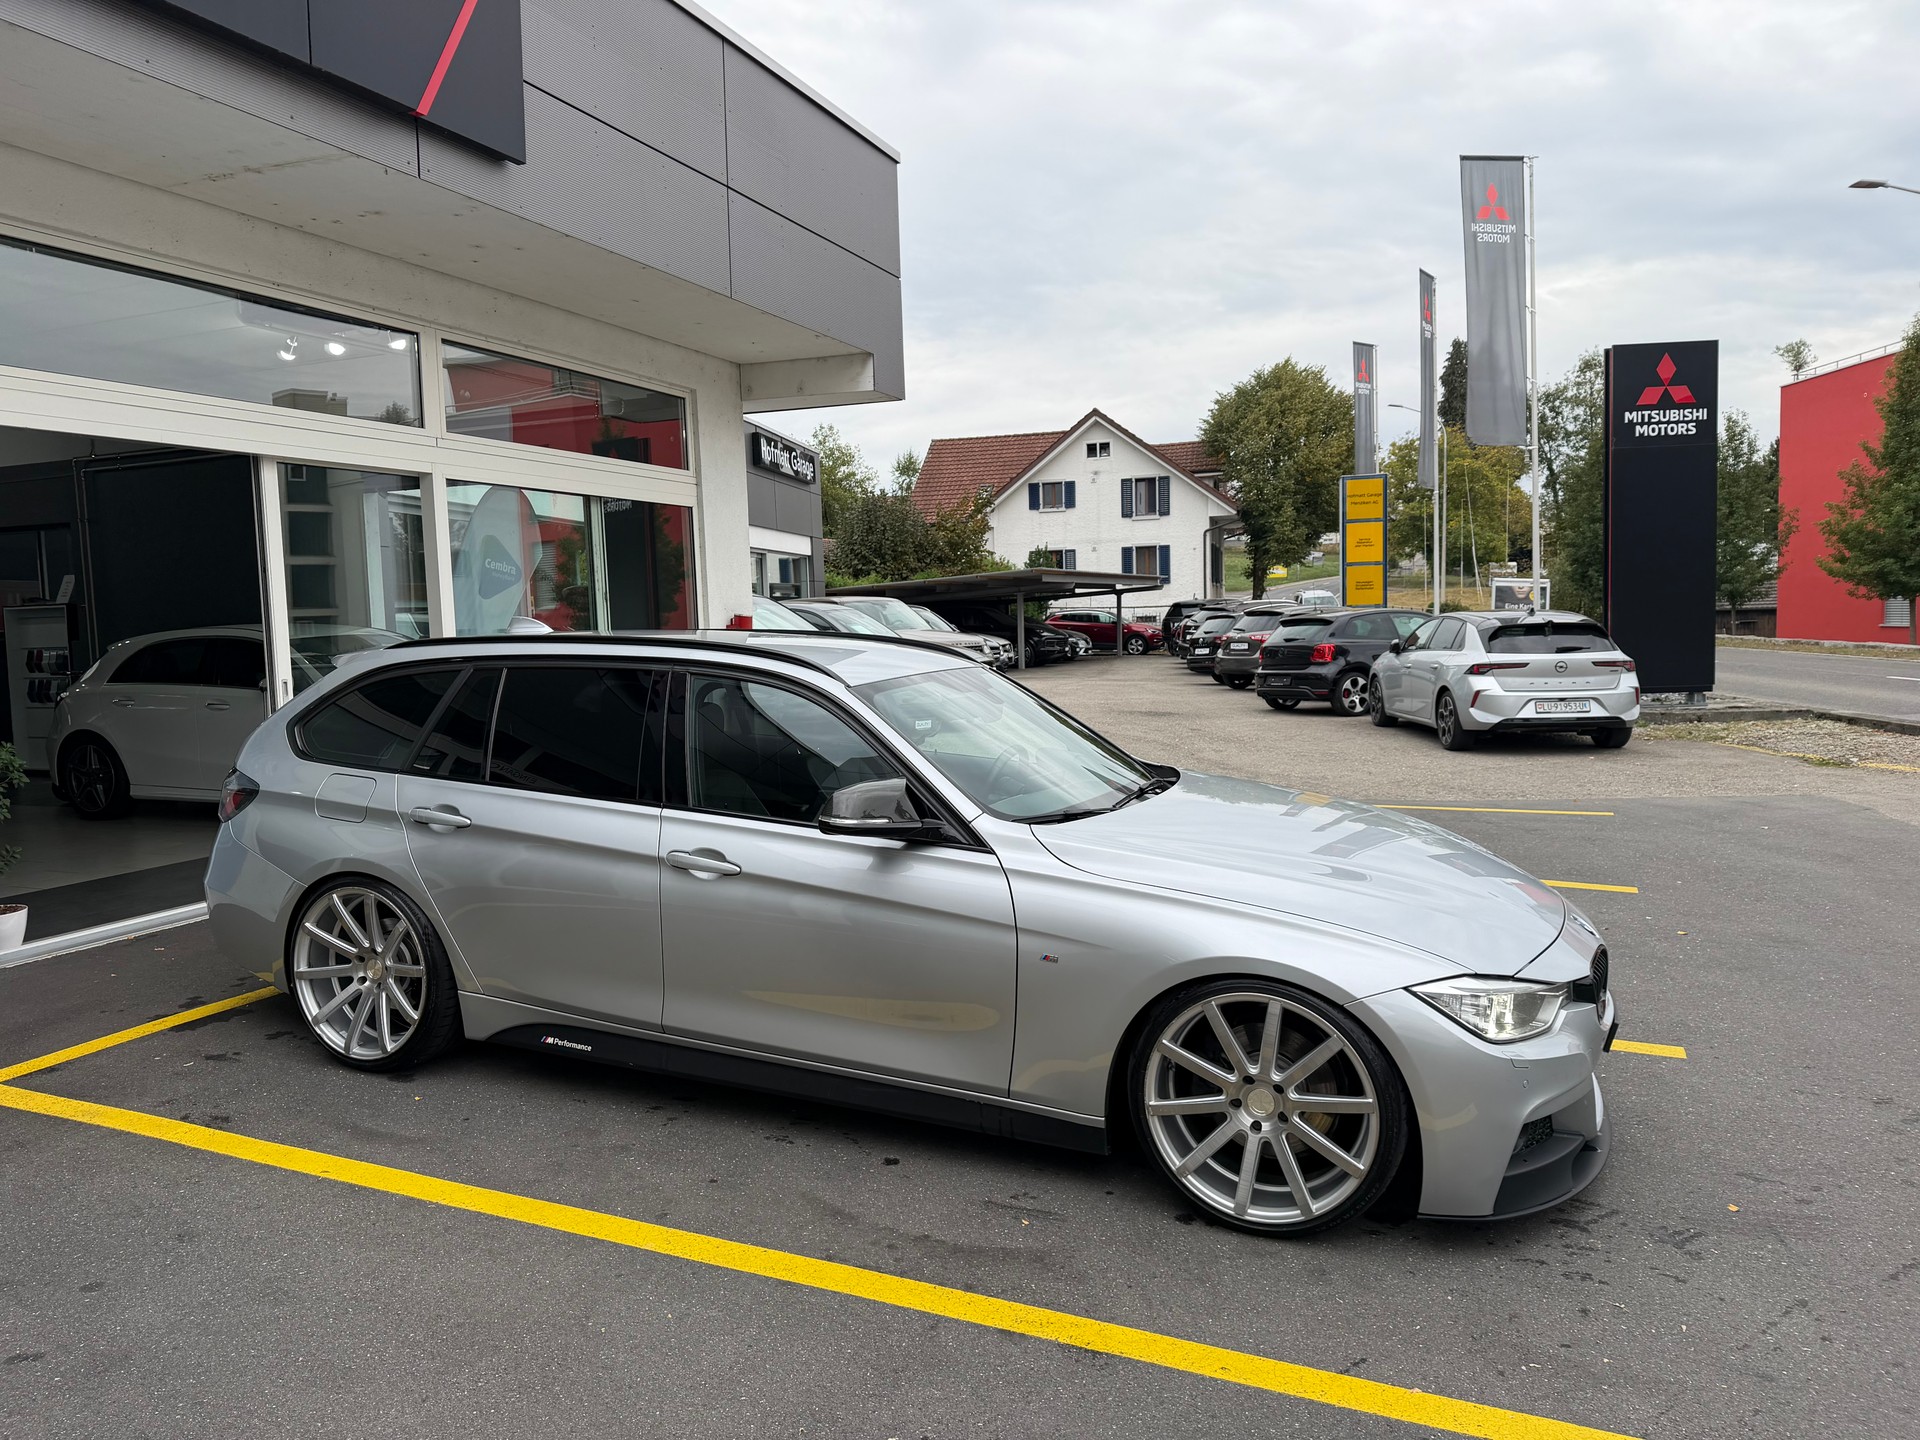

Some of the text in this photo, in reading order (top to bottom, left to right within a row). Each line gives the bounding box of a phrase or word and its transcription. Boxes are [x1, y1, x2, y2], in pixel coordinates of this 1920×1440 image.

[1624, 408, 1708, 423] MITSUBISHI
[1635, 423, 1697, 437] MOTORS
[760, 437, 814, 481] Hofmatt Garage
[485, 558, 516, 575] Cembra
[554, 1038, 592, 1051] Performance
